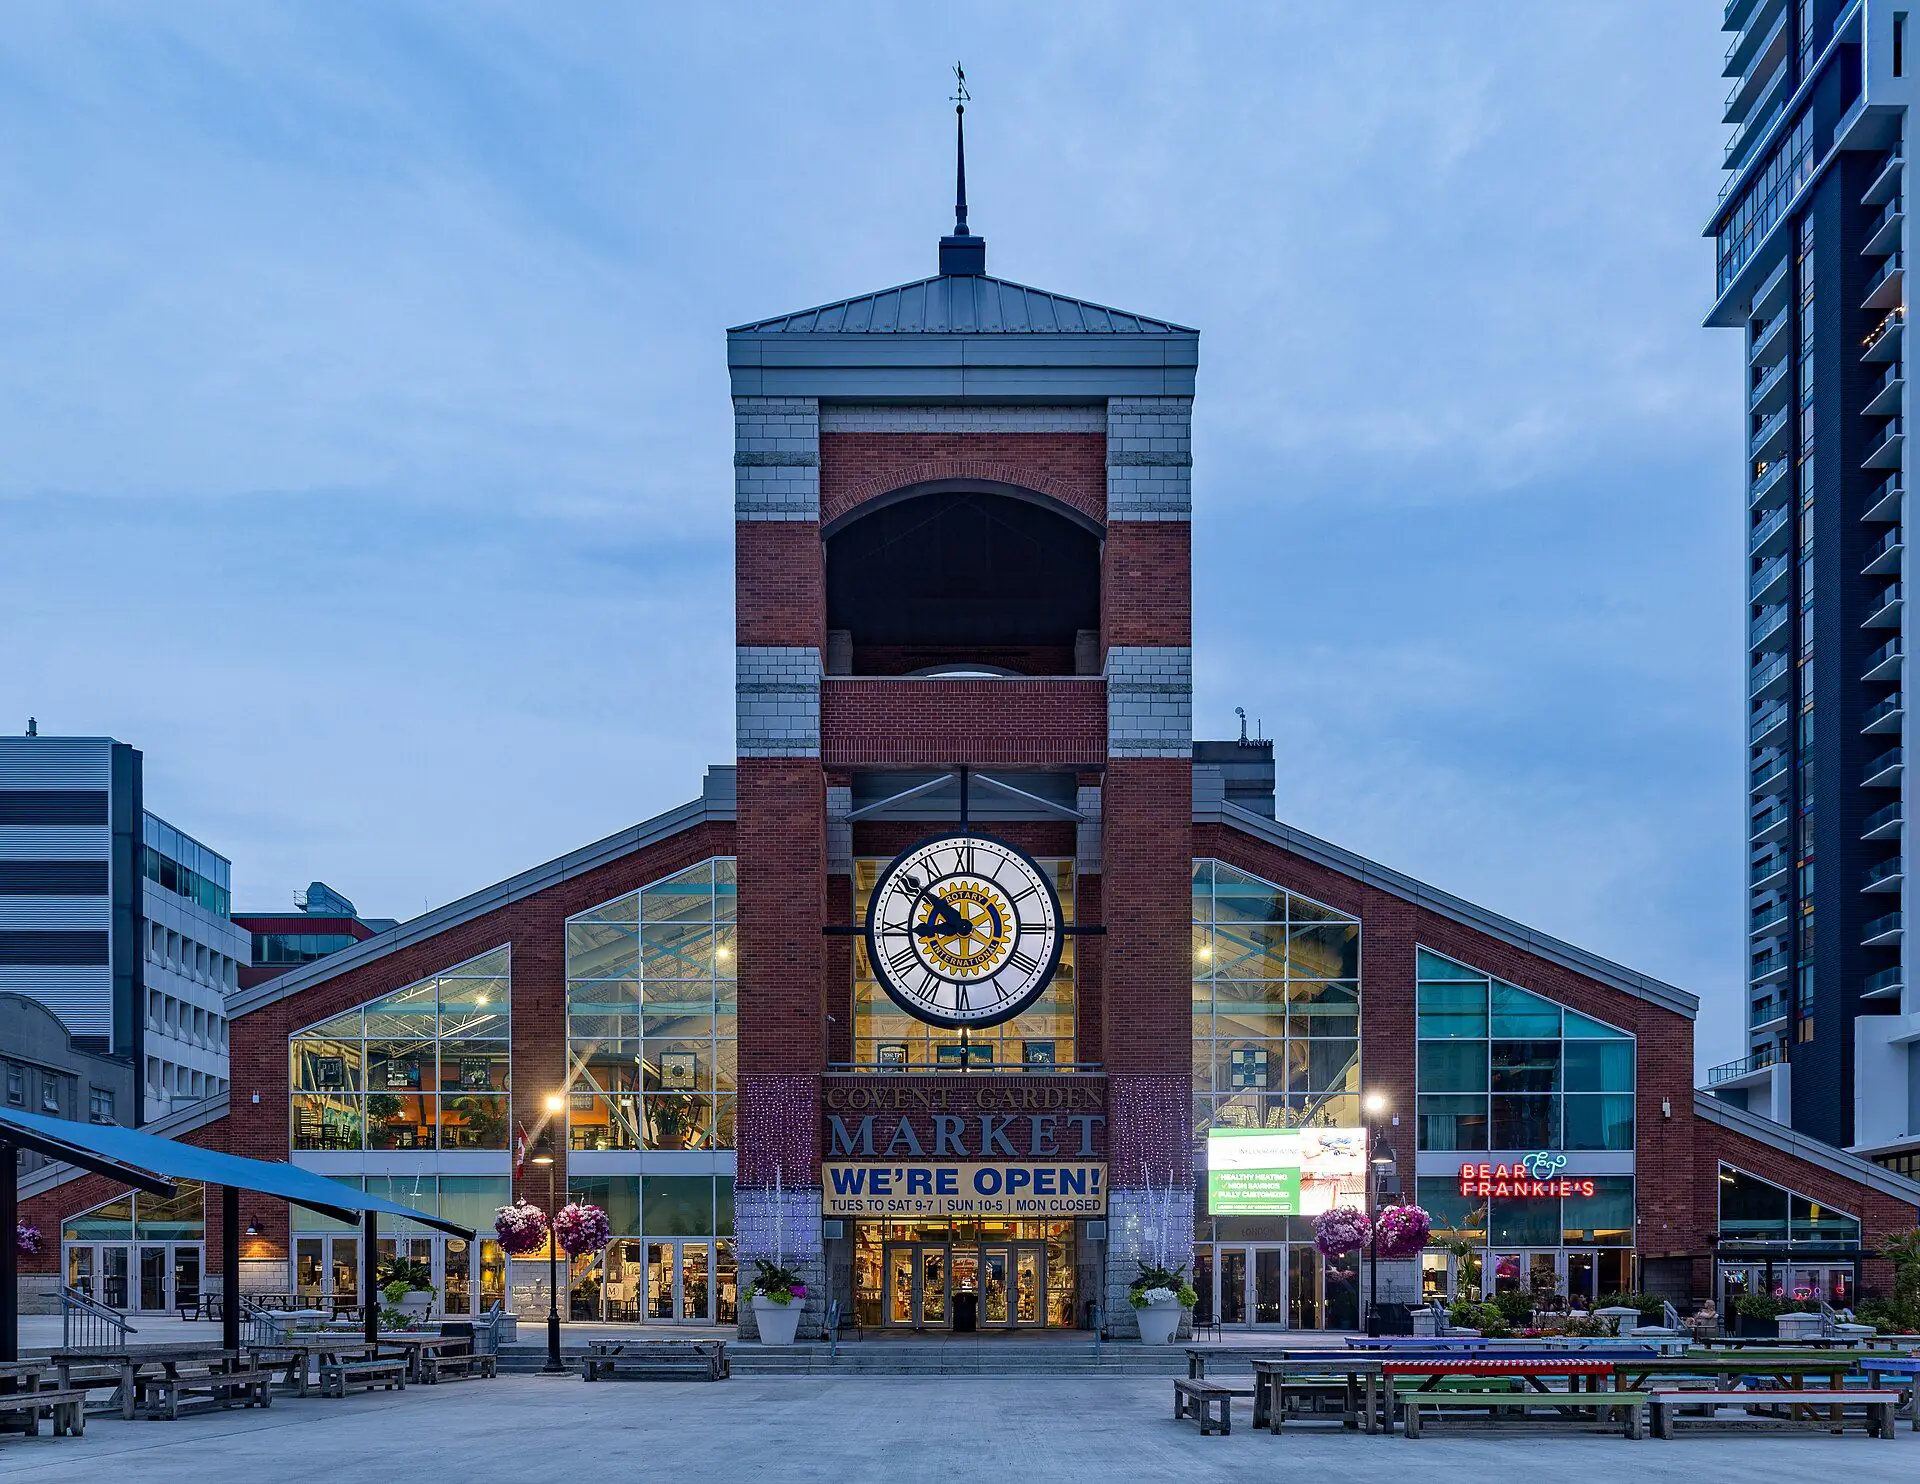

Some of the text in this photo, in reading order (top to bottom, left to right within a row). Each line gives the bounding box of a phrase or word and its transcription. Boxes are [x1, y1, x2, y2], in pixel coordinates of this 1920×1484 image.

[954, 847, 974, 873] XII
[946, 892, 984, 904] ROTARY
[1020, 923, 1046, 935] III
[931, 940, 998, 967] INTERNATIONAL
[826, 1087, 1104, 1109] COVENT GARDEN
[826, 1114, 1107, 1157] MARKET
[1255, 1173, 1288, 1181] HEATING
[1462, 1164, 1526, 1179] BEAR
[830, 1168, 1101, 1196] WE'RE OPEN!
[1462, 1181, 1594, 1197] FRANKIE'S
[830, 1199, 1101, 1211] TUES TO SAT 9-7 SUN 10-5 MON CLOSED
